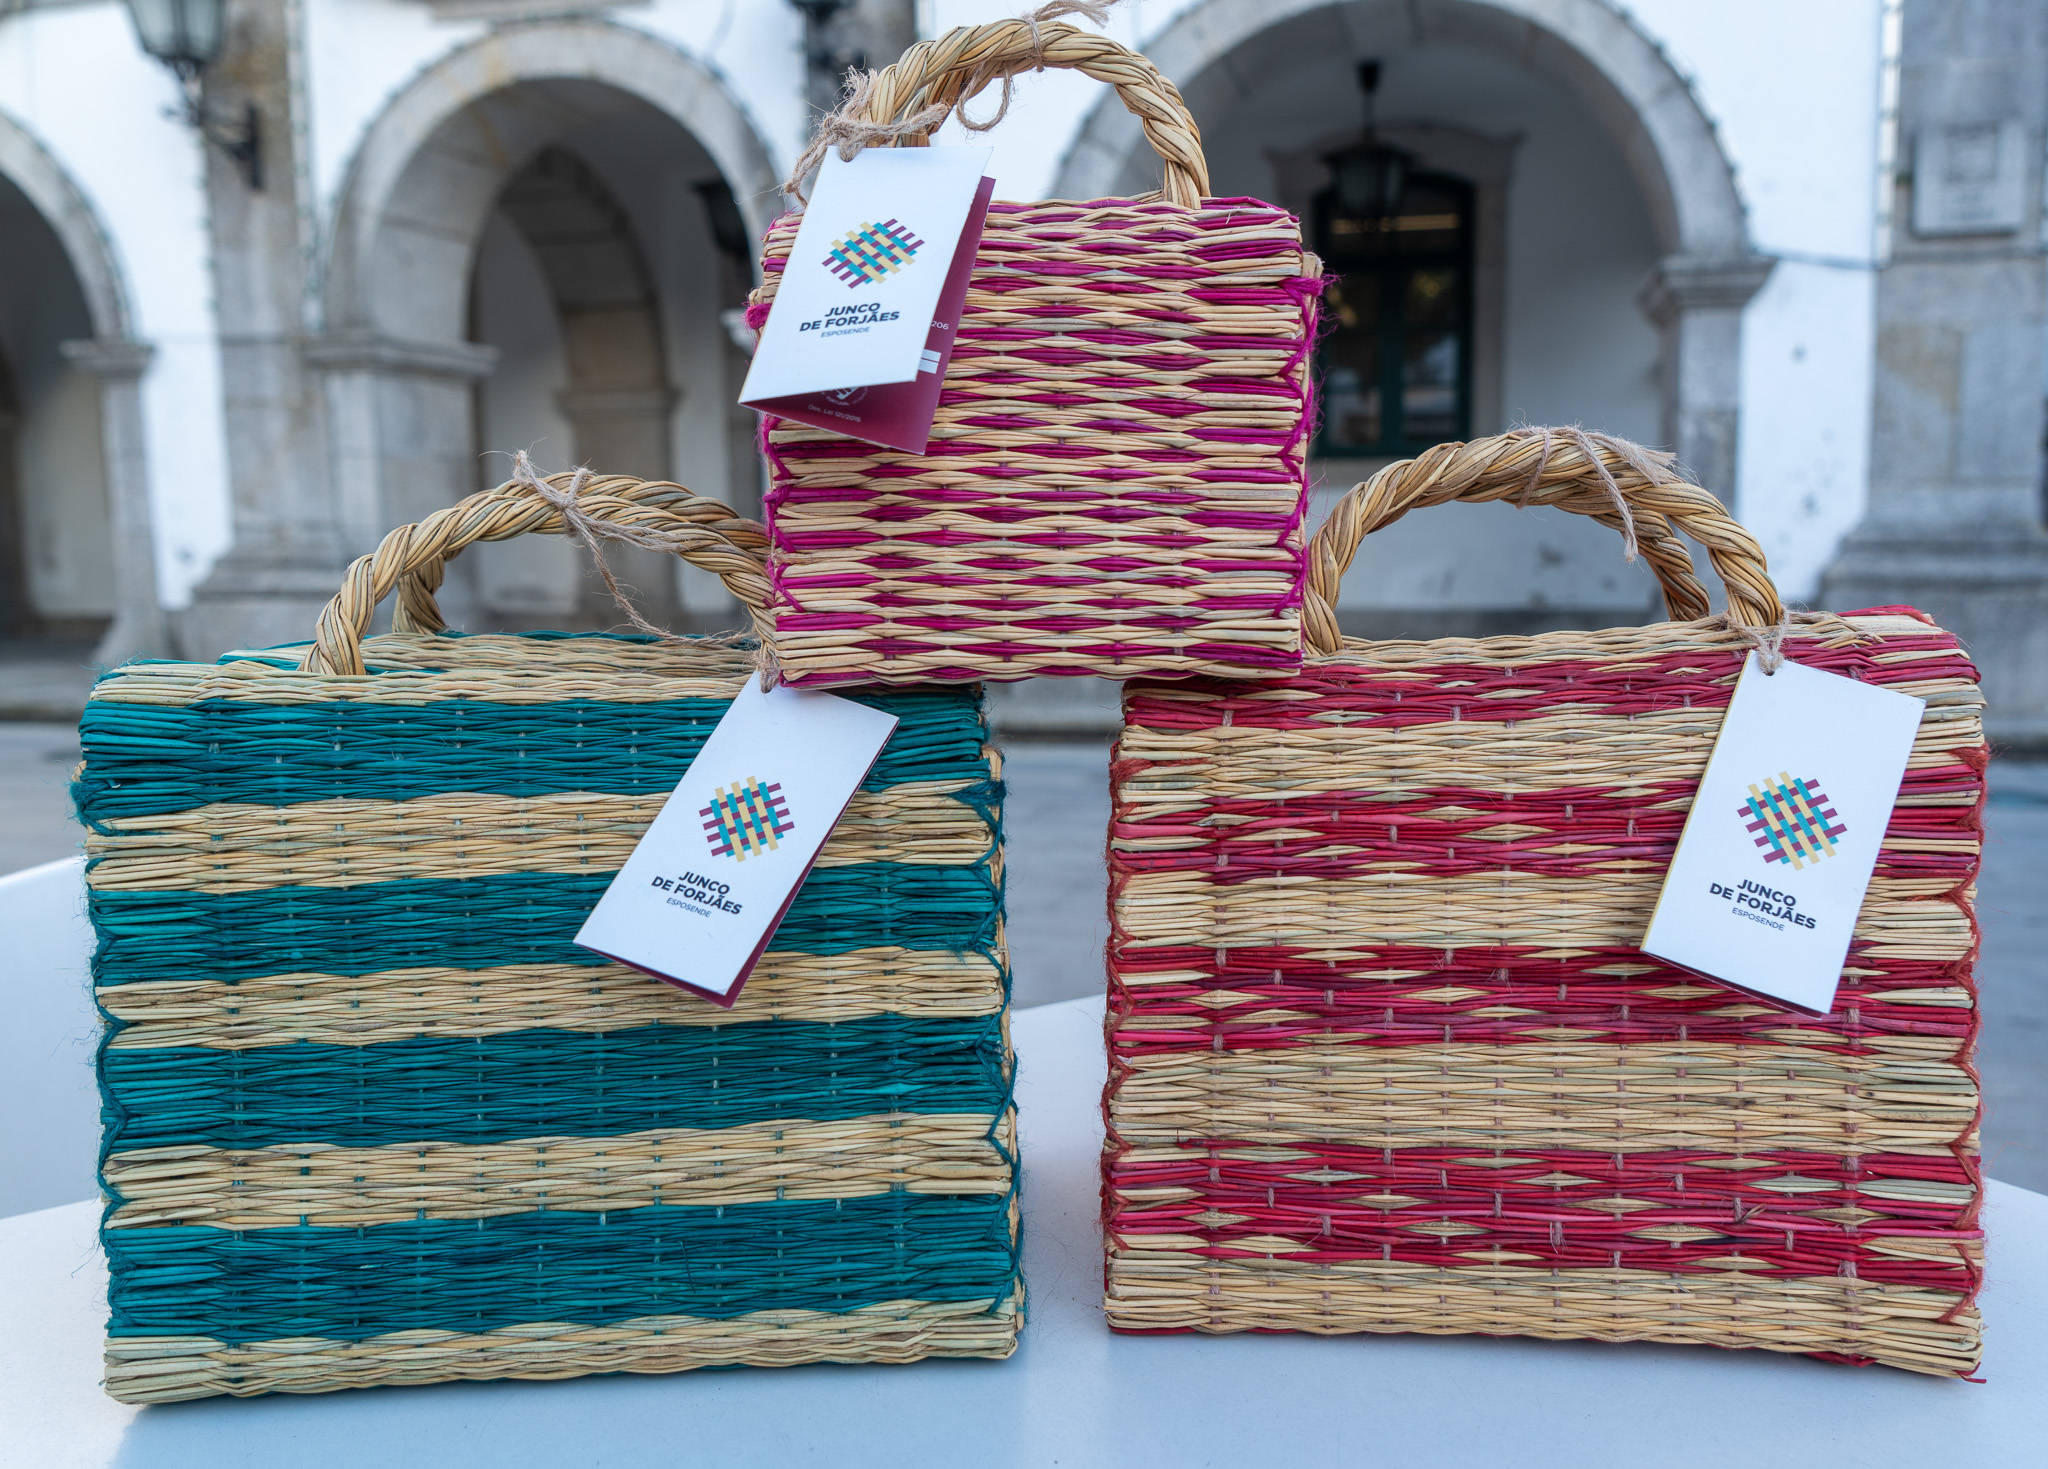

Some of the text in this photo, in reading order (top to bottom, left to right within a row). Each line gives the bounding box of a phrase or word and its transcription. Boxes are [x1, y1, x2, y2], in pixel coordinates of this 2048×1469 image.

[799, 311, 900, 332] DE FORJÃES
[824, 302, 881, 317] JUNCO
[820, 326, 871, 338] ESPOSENDE
[678, 871, 731, 895] JUNCO
[1736, 879, 1797, 907] JUNCO
[650, 876, 743, 915] DE FORJÃES
[666, 897, 712, 918] ESPOSENDE
[1709, 882, 1817, 929] DE FORJÃES
[1731, 907, 1785, 931] ESPOSENDE
